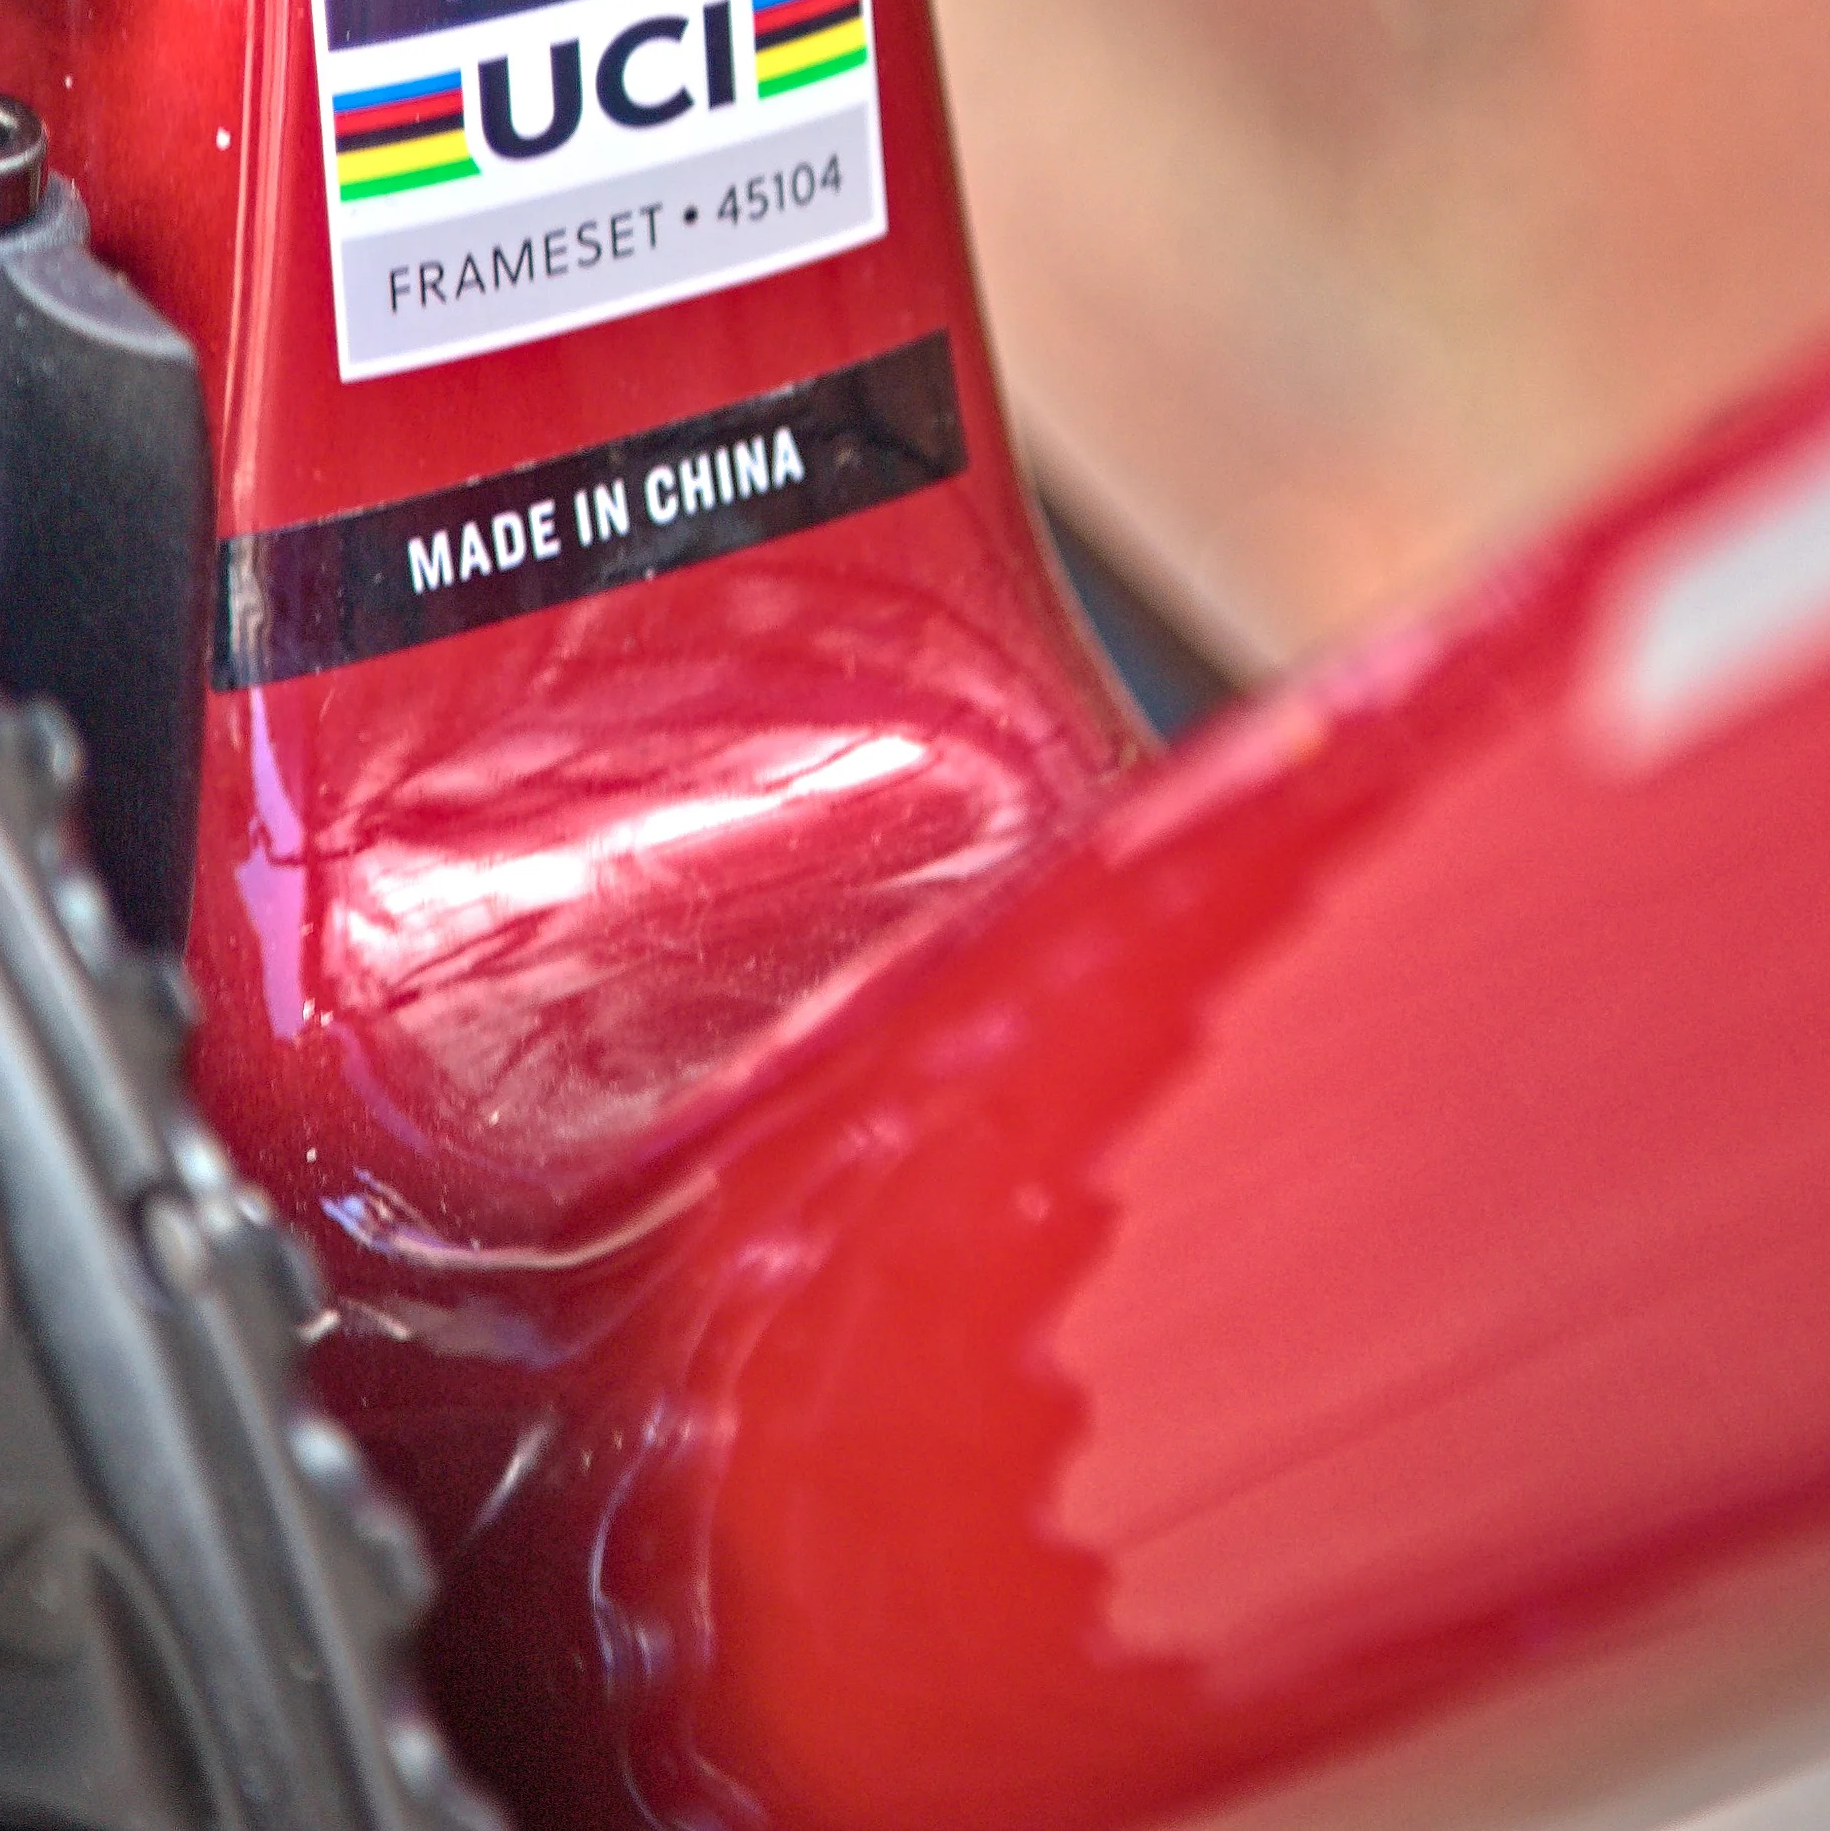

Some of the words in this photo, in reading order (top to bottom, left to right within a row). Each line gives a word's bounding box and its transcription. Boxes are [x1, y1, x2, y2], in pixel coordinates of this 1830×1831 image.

[477, 0, 735, 161] UCI
[387, 203, 663, 314] FRAMESET
[716, 154, 844, 225] 45104
[407, 499, 561, 594] MADE
[574, 479, 630, 547] IN
[644, 427, 805, 525] CHINA
